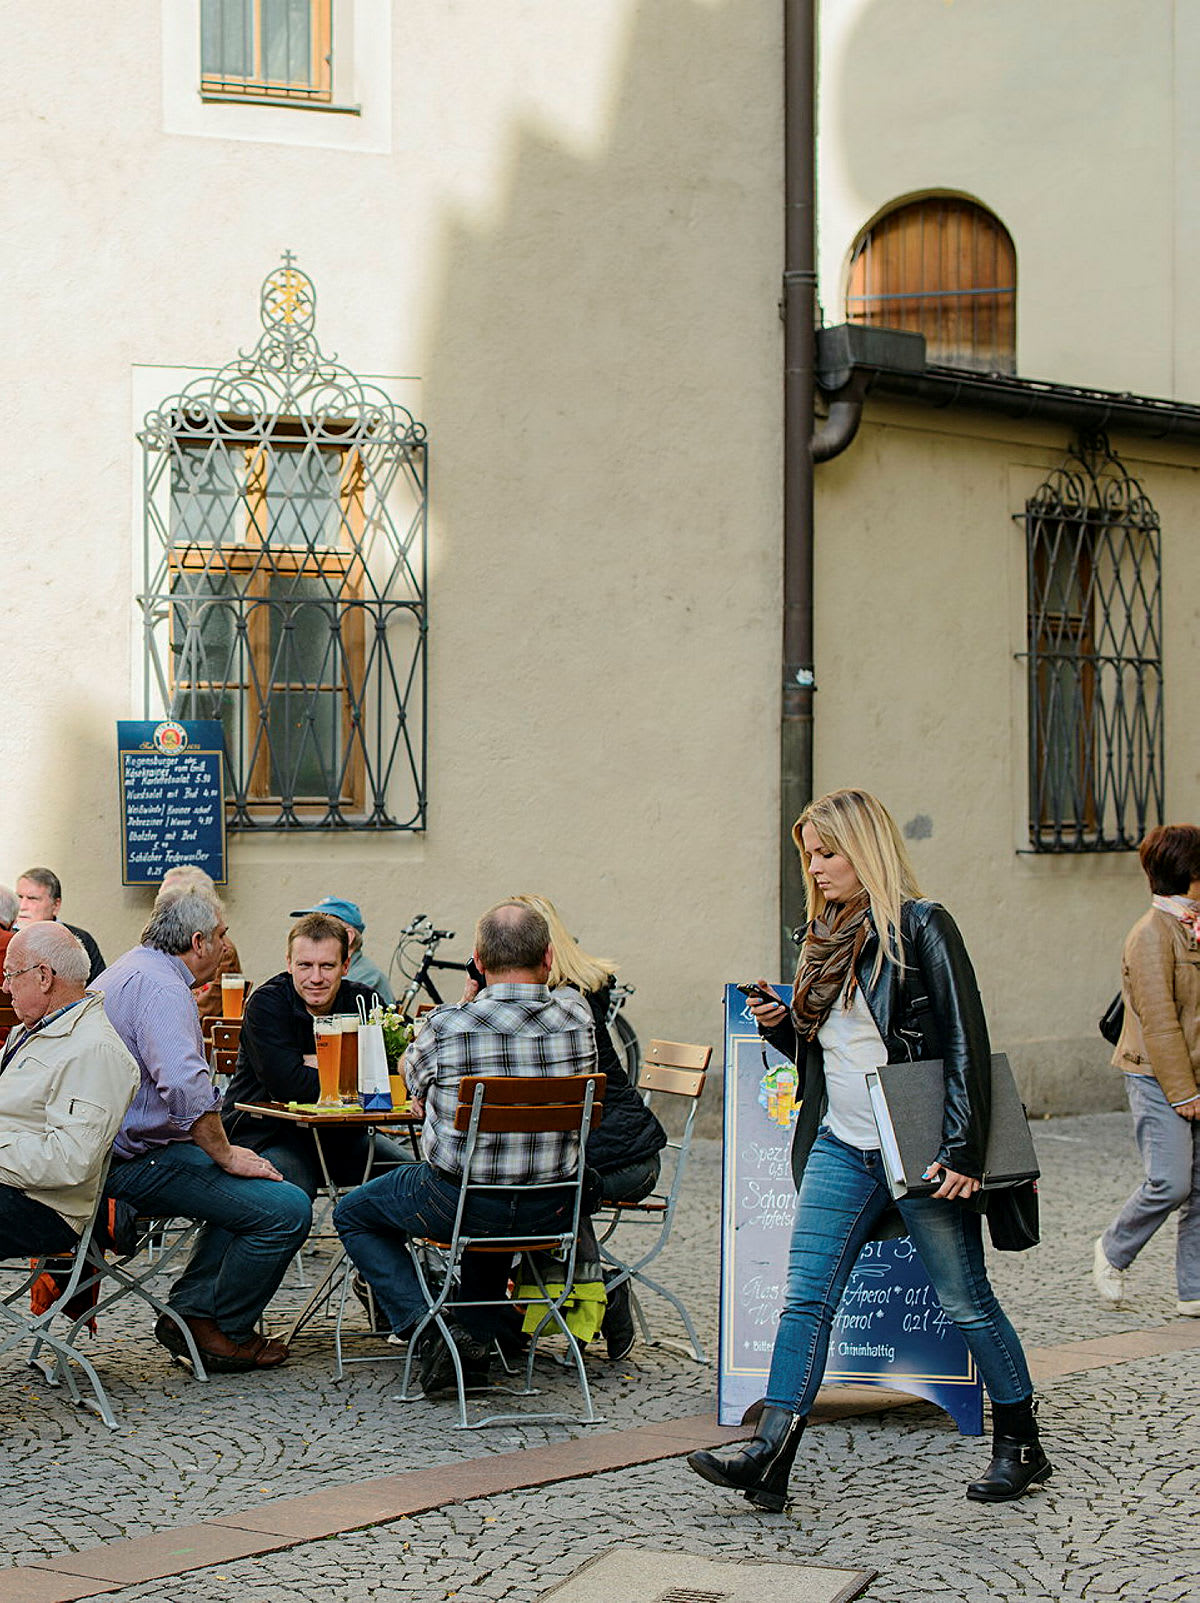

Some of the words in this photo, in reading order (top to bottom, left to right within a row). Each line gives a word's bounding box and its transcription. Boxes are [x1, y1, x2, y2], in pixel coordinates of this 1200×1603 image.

[741, 1141, 792, 1169] Spezi
[741, 1181, 798, 1210] Schorl
[838, 1341, 895, 1363] Chininhaltig
